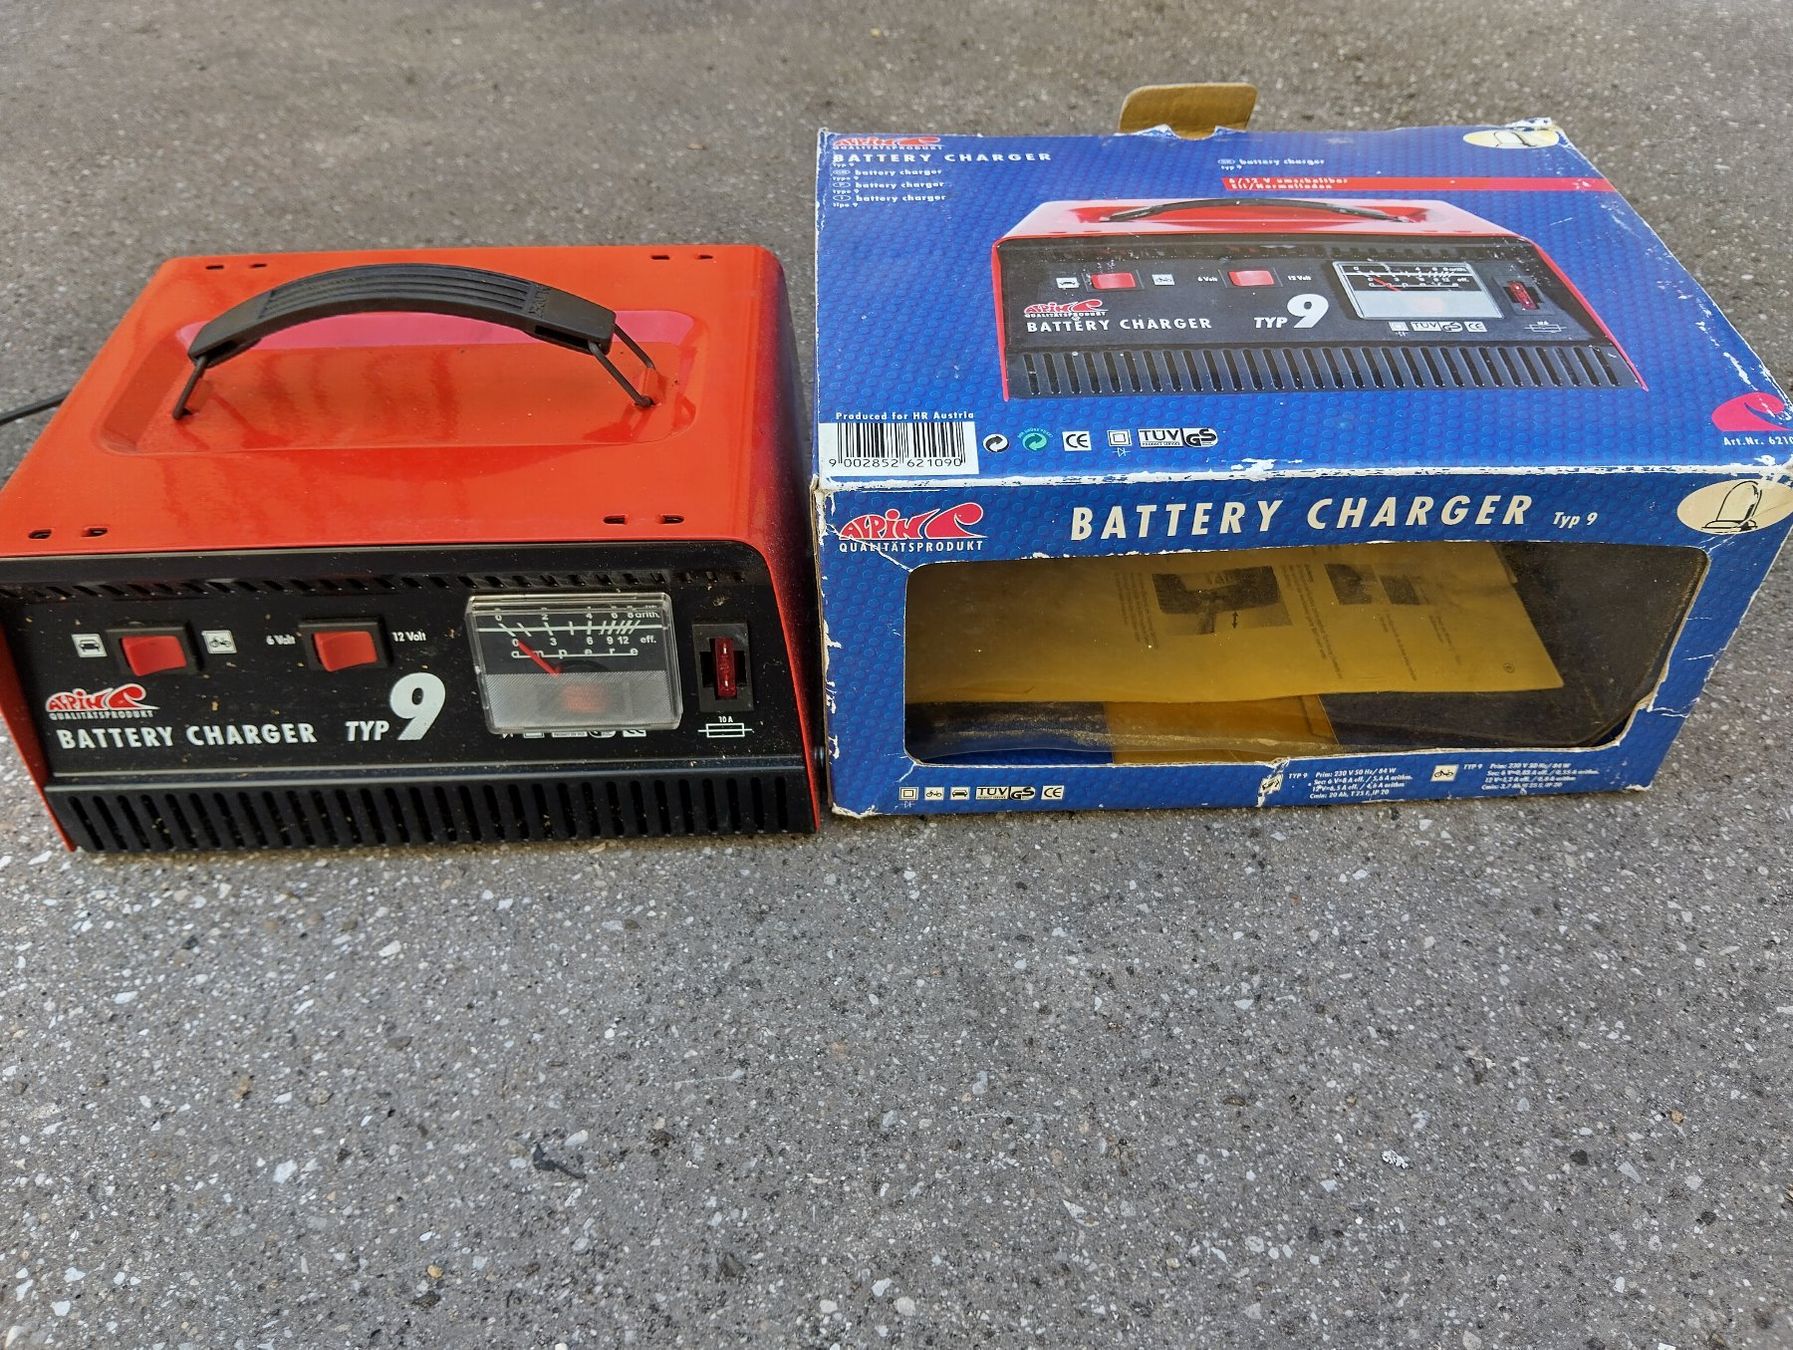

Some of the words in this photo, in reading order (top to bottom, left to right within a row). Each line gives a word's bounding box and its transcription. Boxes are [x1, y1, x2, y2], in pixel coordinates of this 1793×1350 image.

[832, 154, 932, 162] BATTERY
[944, 152, 1052, 162] CHARGER
[856, 195, 898, 203] battery
[1027, 319, 1110, 333] BATTERY
[1119, 318, 1212, 330] CHARGER
[1254, 317, 1288, 329] TYP
[1287, 293, 1329, 329] 9
[836, 412, 888, 420] Produced
[892, 412, 909, 420] for
[913, 412, 928, 420] HR
[933, 411, 974, 420] Austria
[1139, 429, 1179, 441] TÜV
[829, 458, 837, 468] 9
[844, 458, 899, 468] 002852
[906, 458, 962, 467] 621090
[1071, 500, 1283, 541] BATTERY
[1307, 495, 1533, 530] CHARGER
[1552, 511, 1582, 529] Typ
[1587, 512, 1598, 526] 9
[839, 540, 983, 553] QUALITÄTSPRODUKT
[266, 635, 273, 646] 6
[274, 633, 296, 645] Volt
[392, 631, 404, 642] 12
[405, 630, 426, 642] Volt
[550, 637, 557, 646] 3
[587, 636, 593, 645] 6
[607, 636, 613, 645] 9
[619, 636, 629, 645] 12
[640, 635, 657, 645] eff.
[56, 726, 173, 750] BATTERY
[186, 723, 318, 747] CHARGER
[345, 721, 390, 743] TYP
[389, 672, 446, 741] 9
